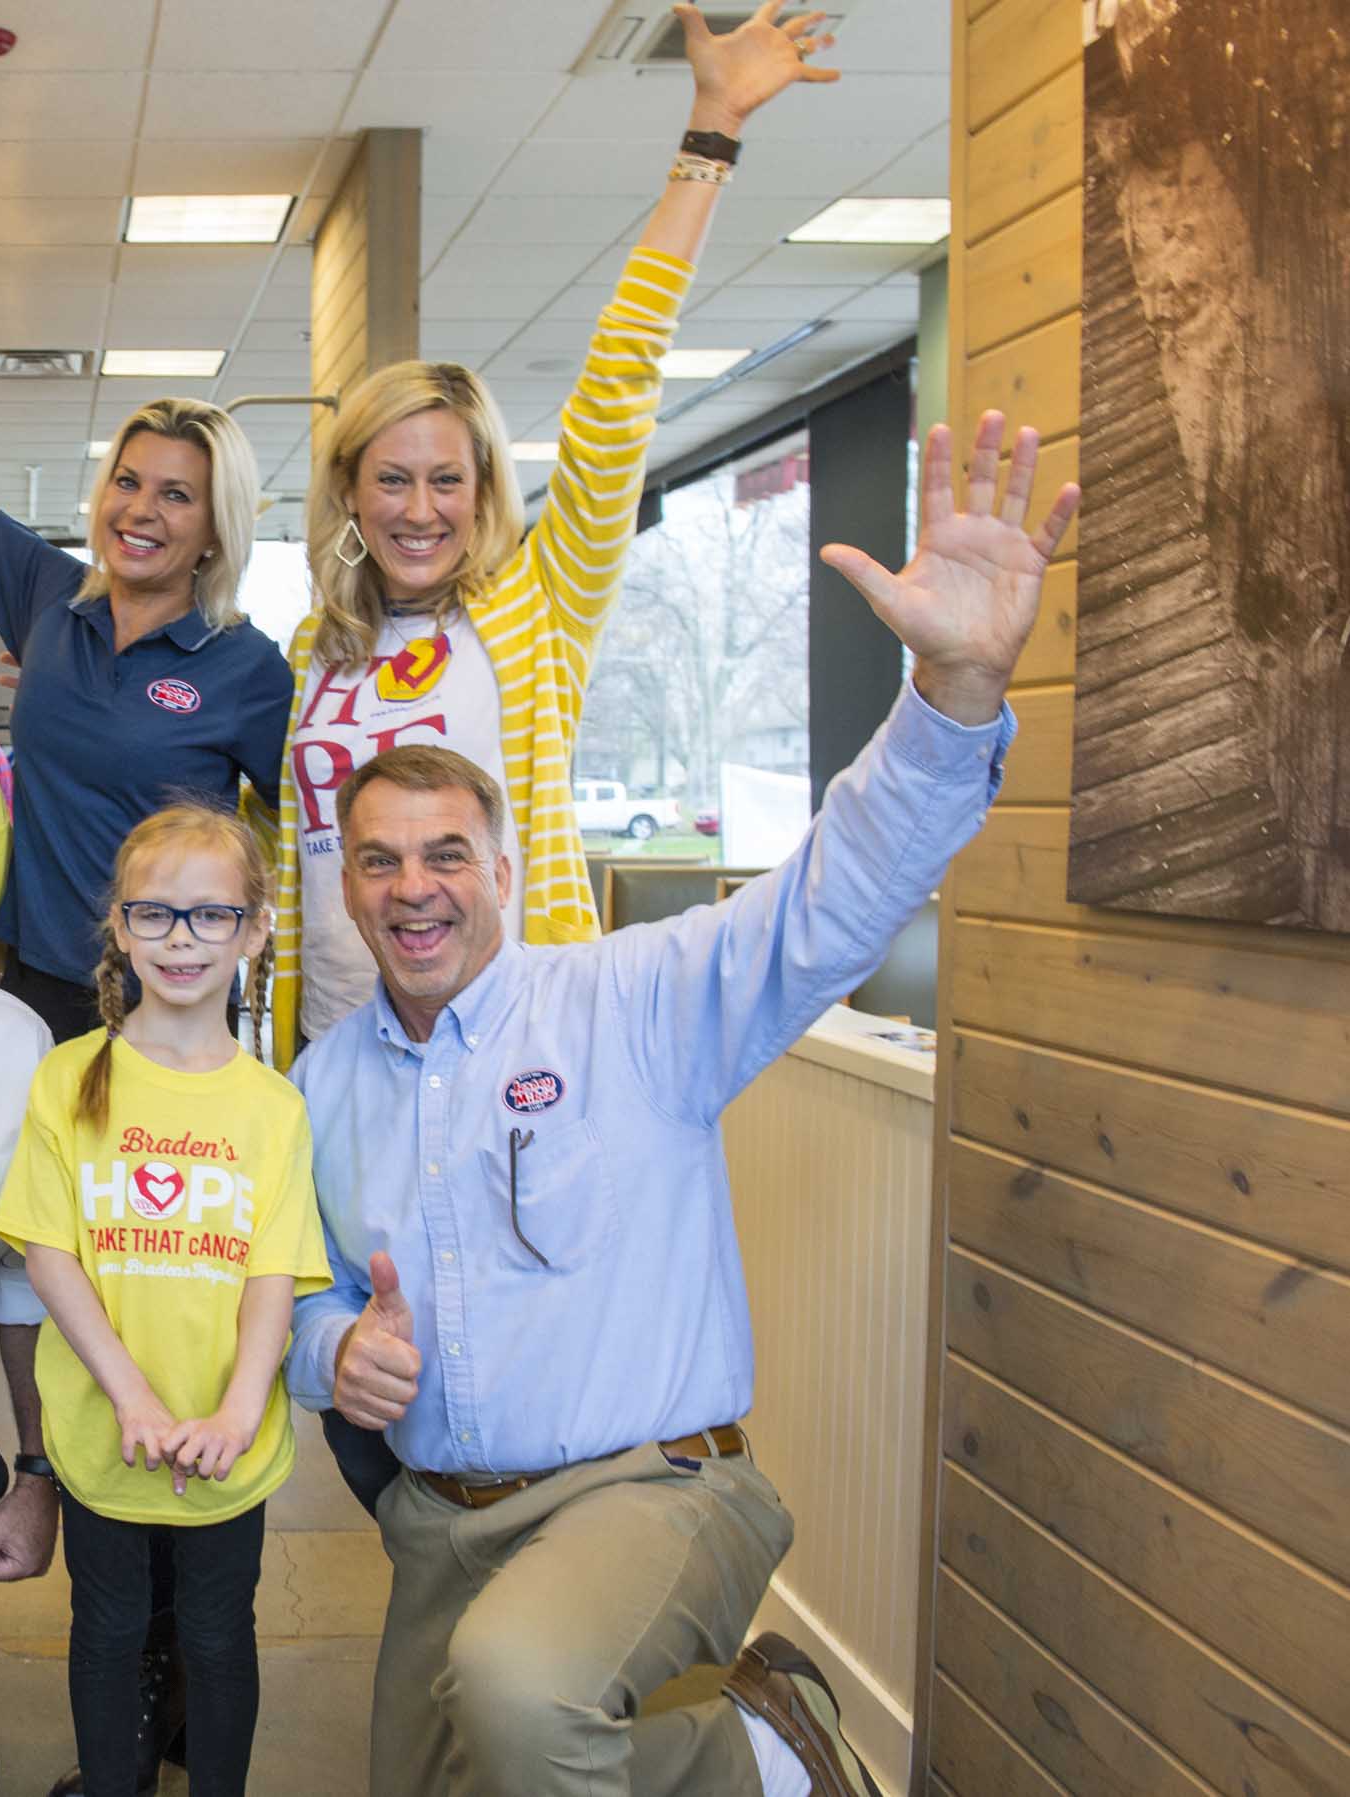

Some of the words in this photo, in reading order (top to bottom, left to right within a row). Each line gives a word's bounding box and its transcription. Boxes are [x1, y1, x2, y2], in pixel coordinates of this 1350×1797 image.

[306, 840, 334, 856] TAKE
[508, 1076, 556, 1097] Jersey
[514, 1090, 558, 1109] Mike's
[119, 1125, 240, 1162] Braden's
[79, 1160, 255, 1233] HOPE
[88, 1227, 127, 1254] TAKE
[131, 1228, 185, 1255] THAT
